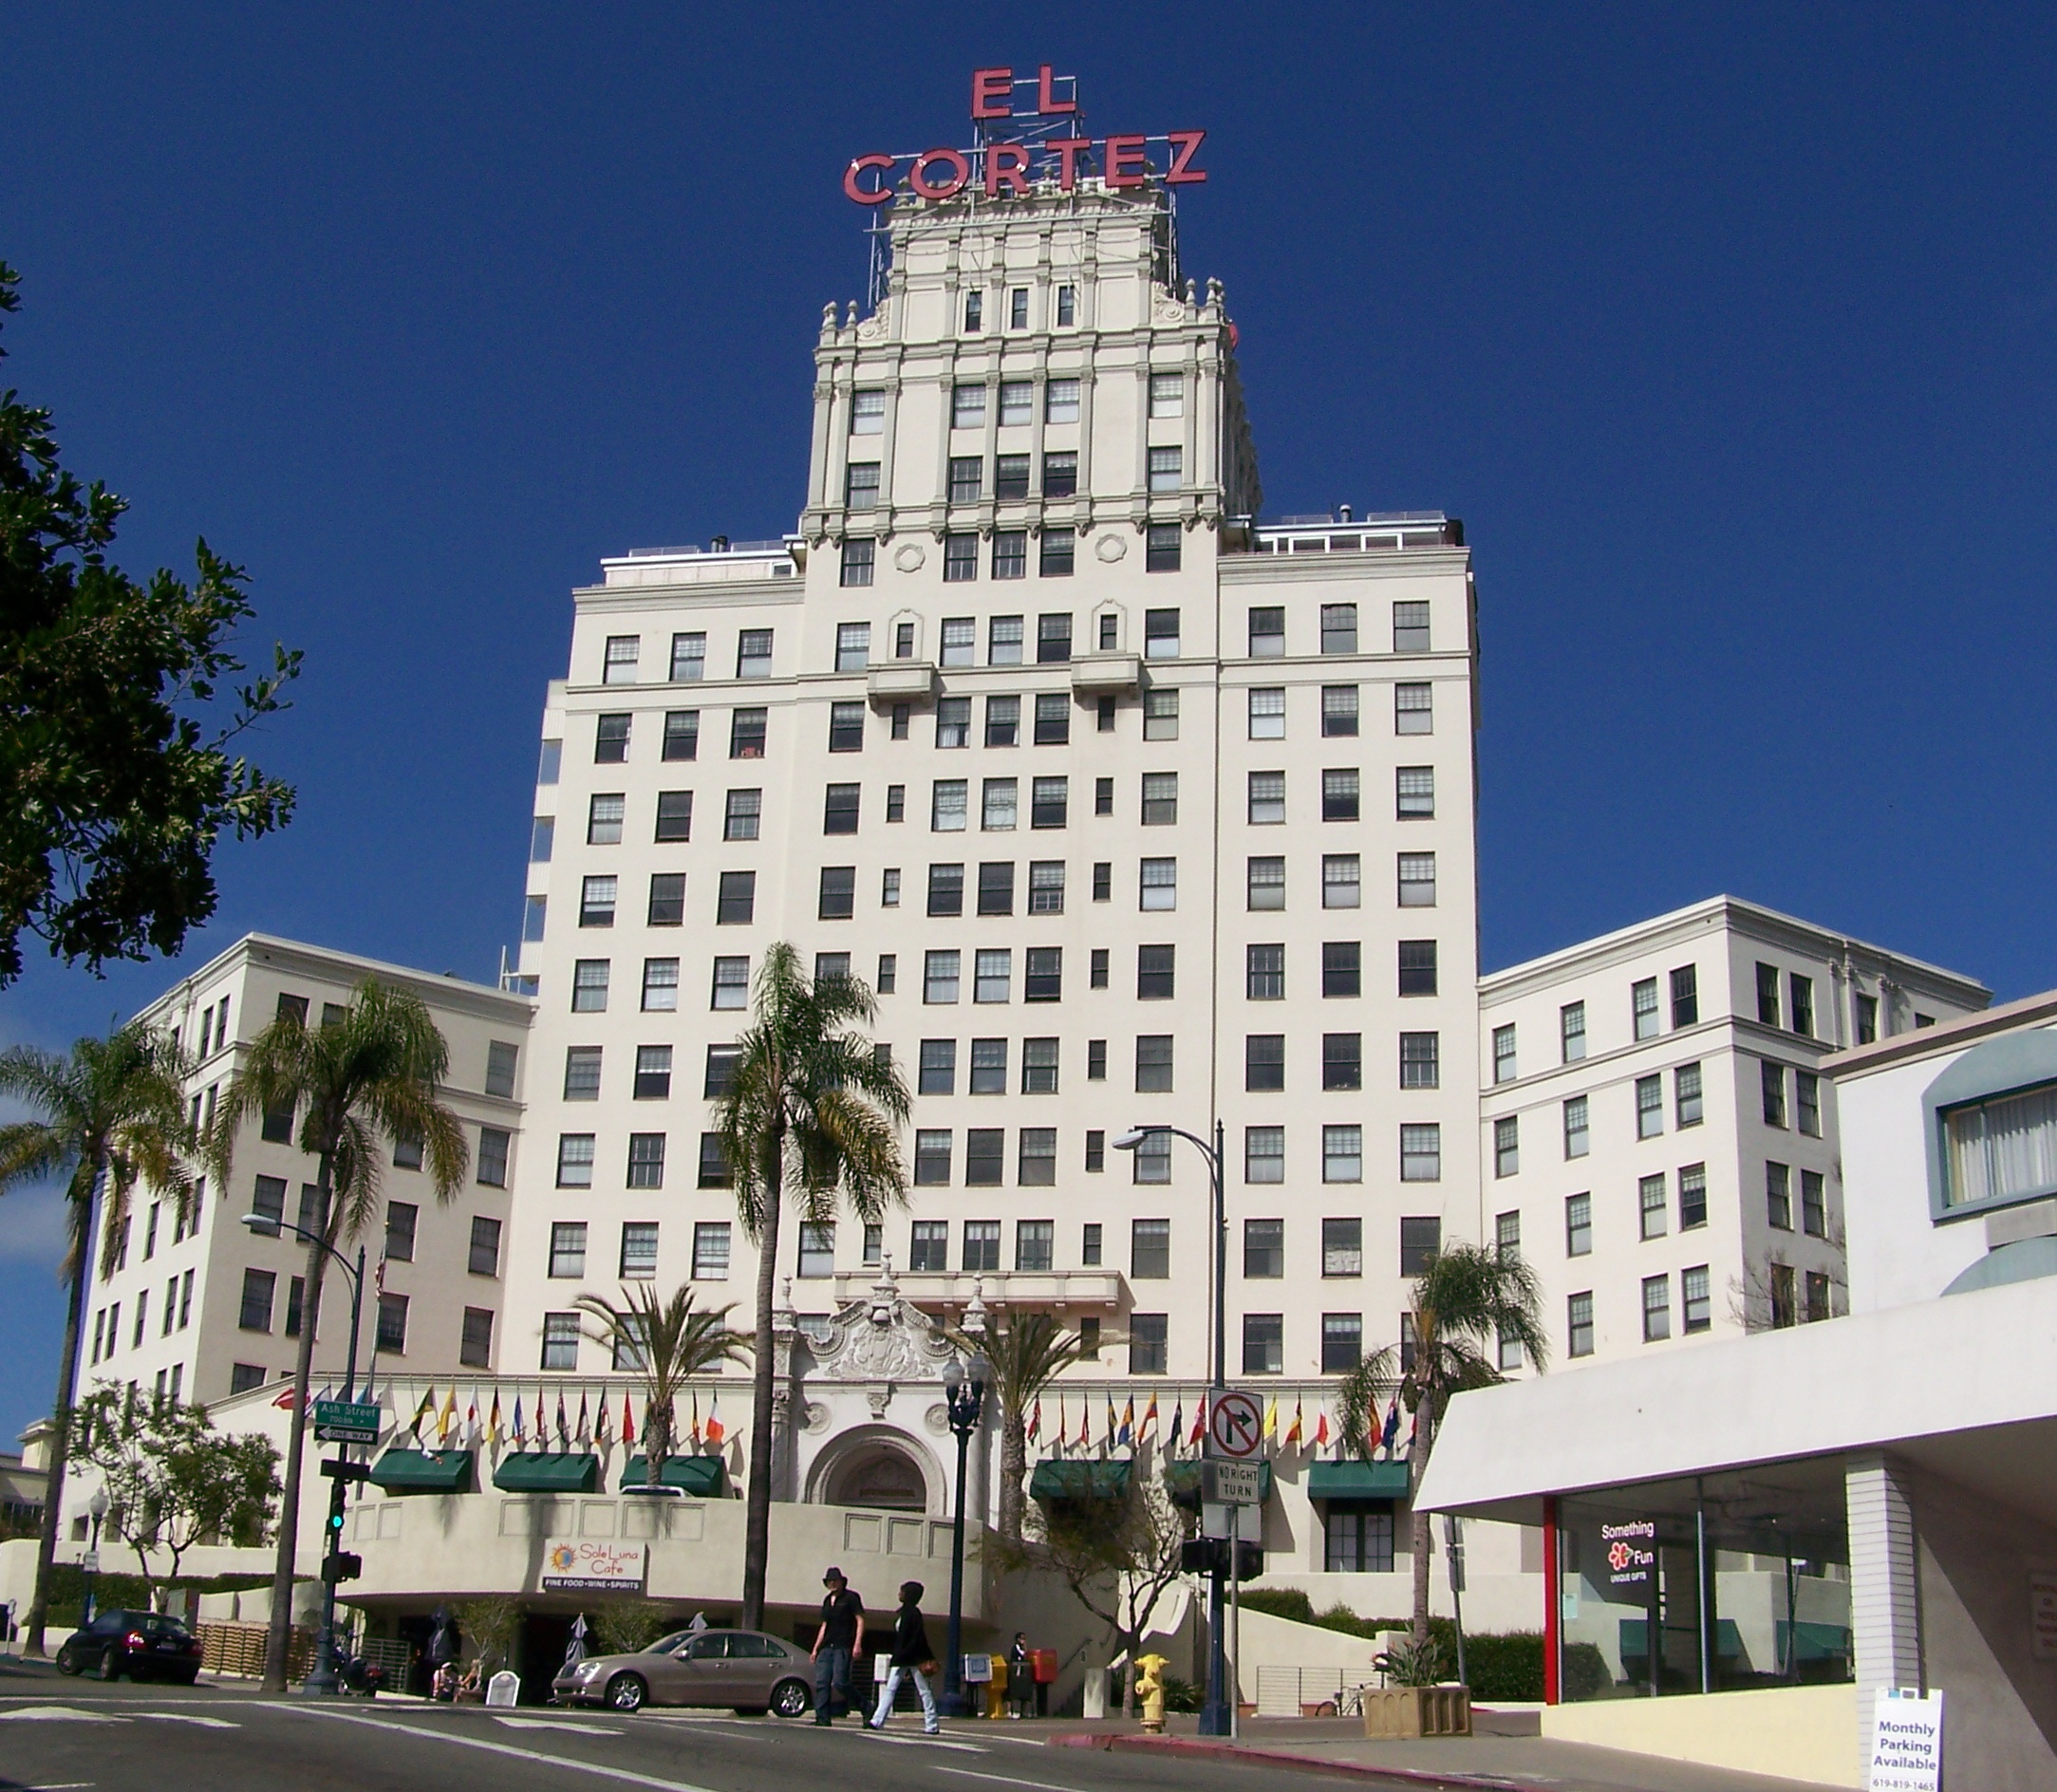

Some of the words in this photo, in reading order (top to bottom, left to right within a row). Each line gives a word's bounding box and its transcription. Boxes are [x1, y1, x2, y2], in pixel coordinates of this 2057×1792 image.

[971, 65, 1076, 119] EL
[842, 130, 1207, 206] CORTEZ
[321, 1403, 340, 1413] Ash
[345, 1406, 376, 1417] Street
[354, 1432, 373, 1441] WAY
[1219, 1465, 1229, 1480] NO
[1230, 1467, 1258, 1482] RIGHT
[1224, 1484, 1251, 1497] TURN
[1601, 1521, 1655, 1540] Something
[1635, 1550, 1654, 1565] Fun
[591, 1559, 623, 1576] Cafe
[1879, 1721, 1935, 1738] Monthly
[1880, 1738, 1932, 1756] Parking
[1874, 1755, 1936, 1771] Available
[1873, 1779, 1935, 1791] 619-819-1465
